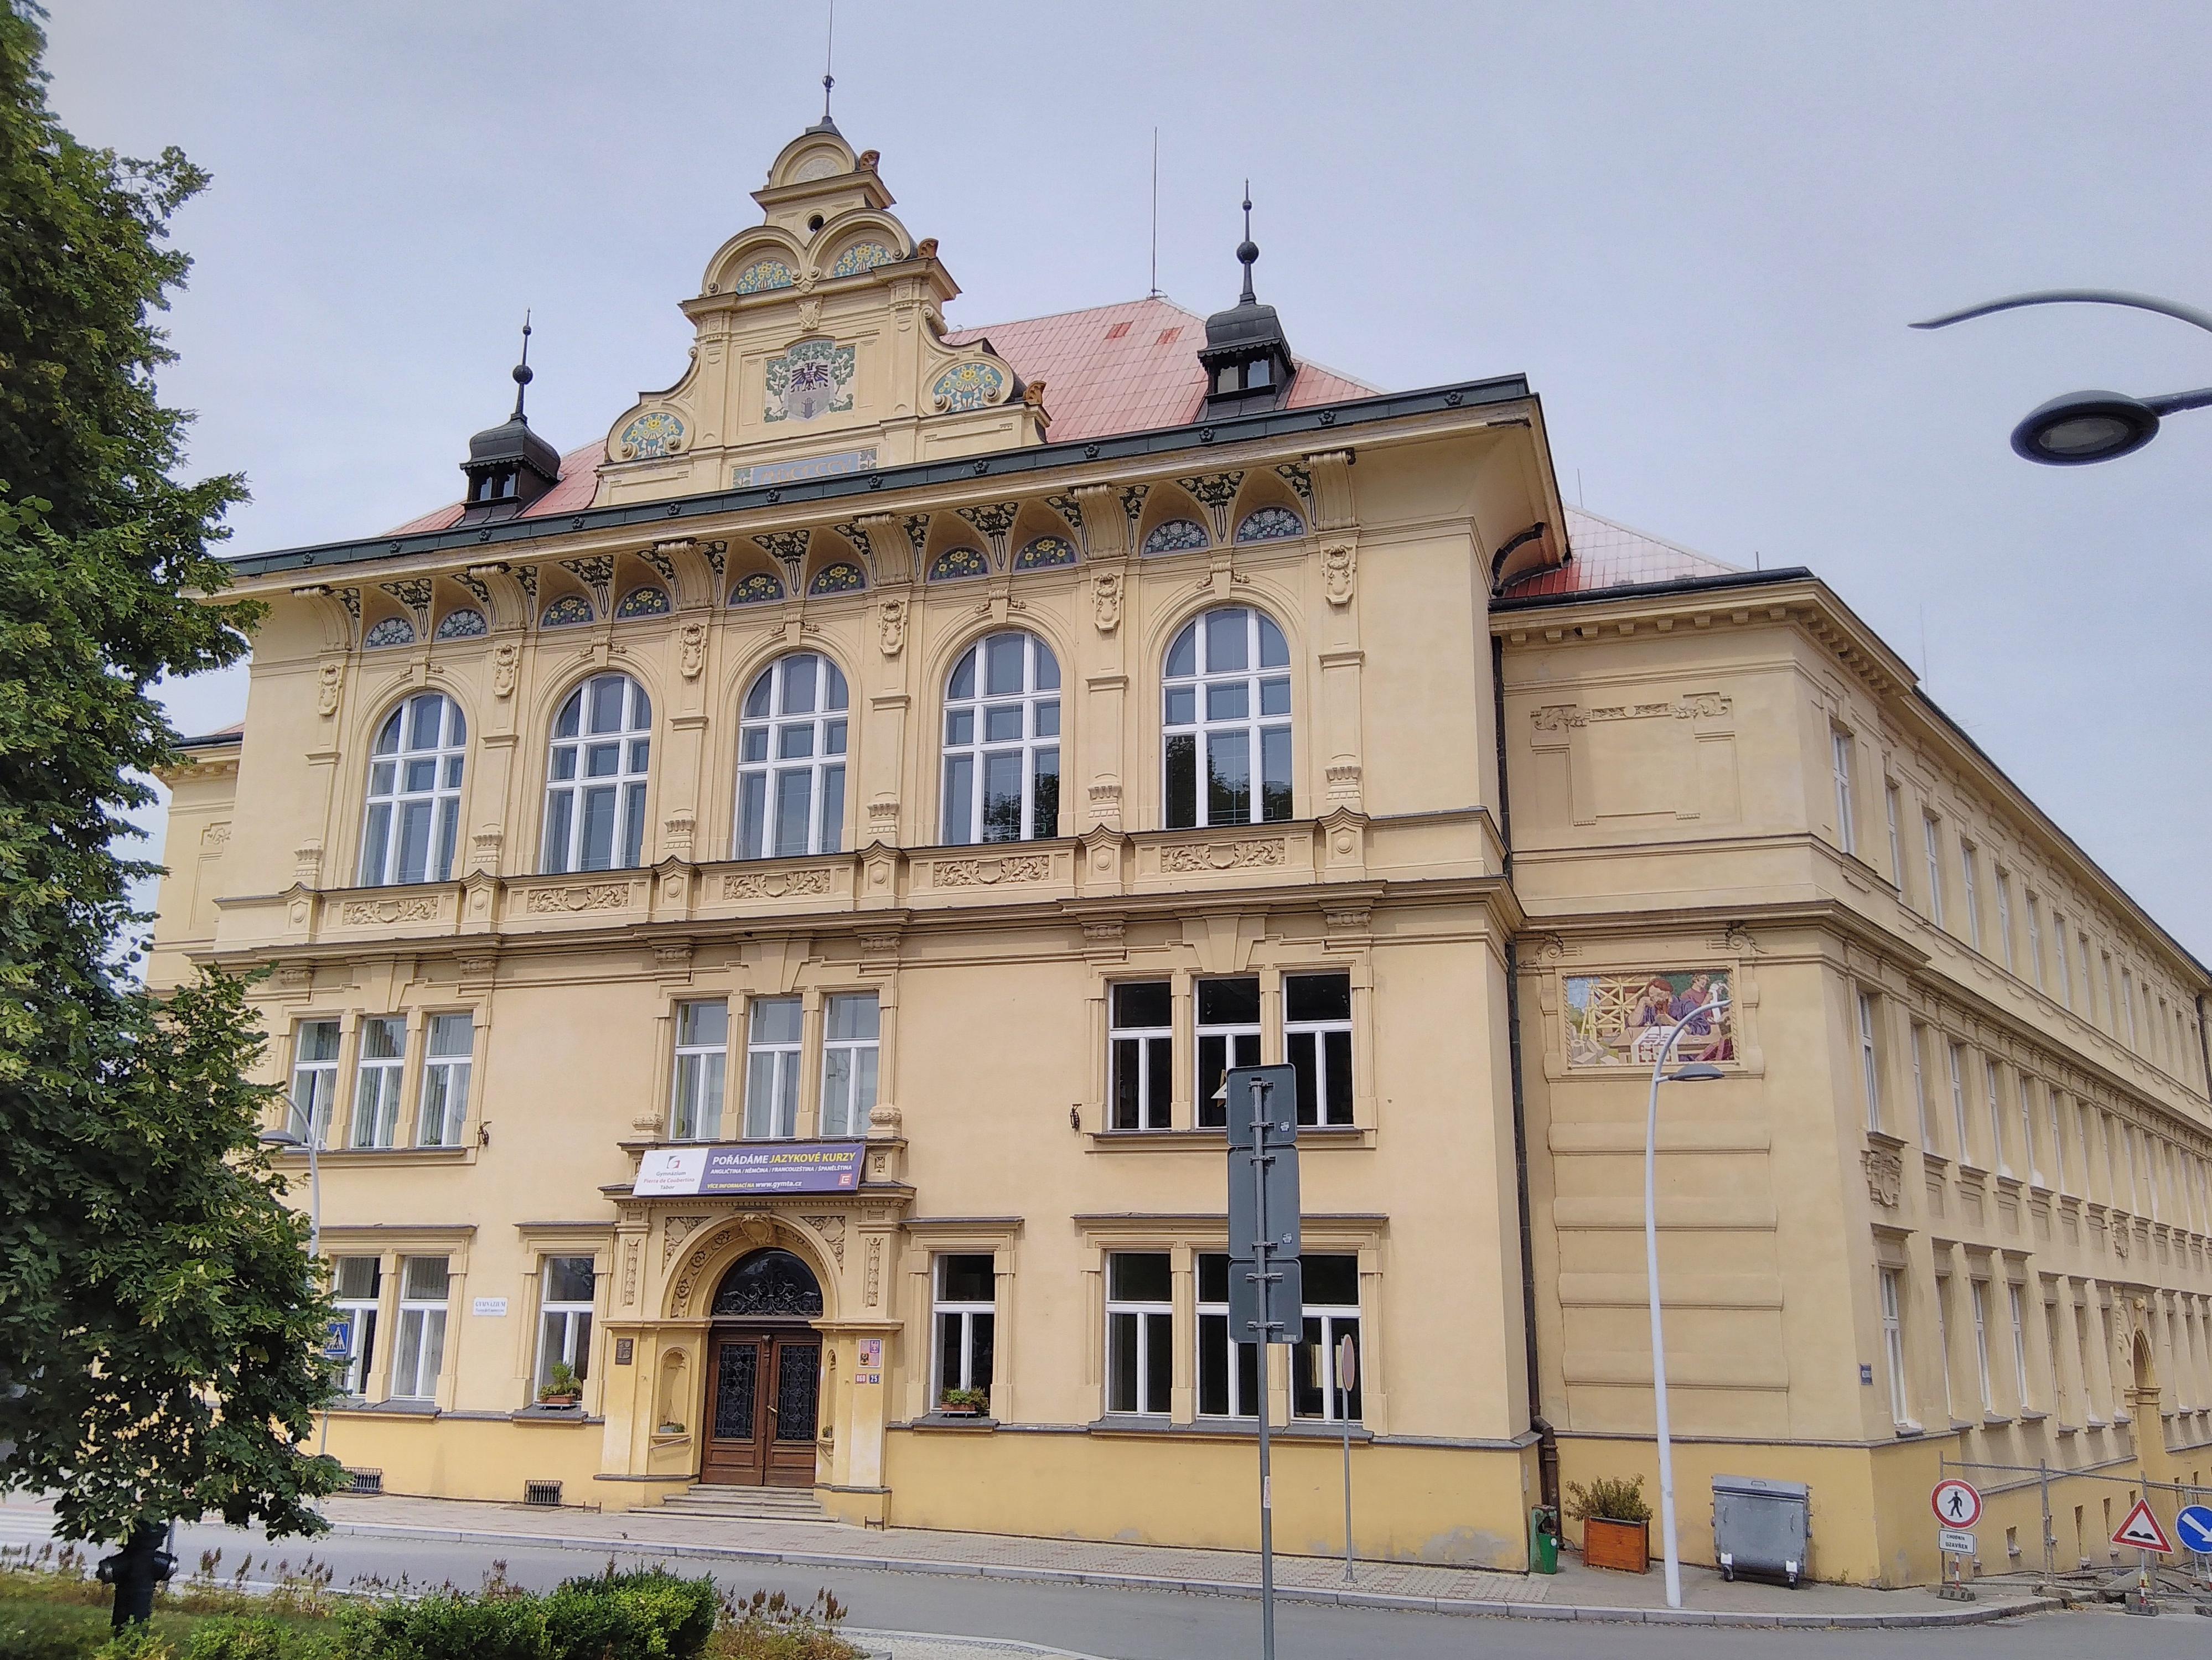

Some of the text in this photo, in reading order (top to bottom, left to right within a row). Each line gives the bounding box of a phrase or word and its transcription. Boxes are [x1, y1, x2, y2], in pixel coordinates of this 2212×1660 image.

[712, 1152, 856, 1165] POŘÁDÁME JAZYKOVÉ KURZY
